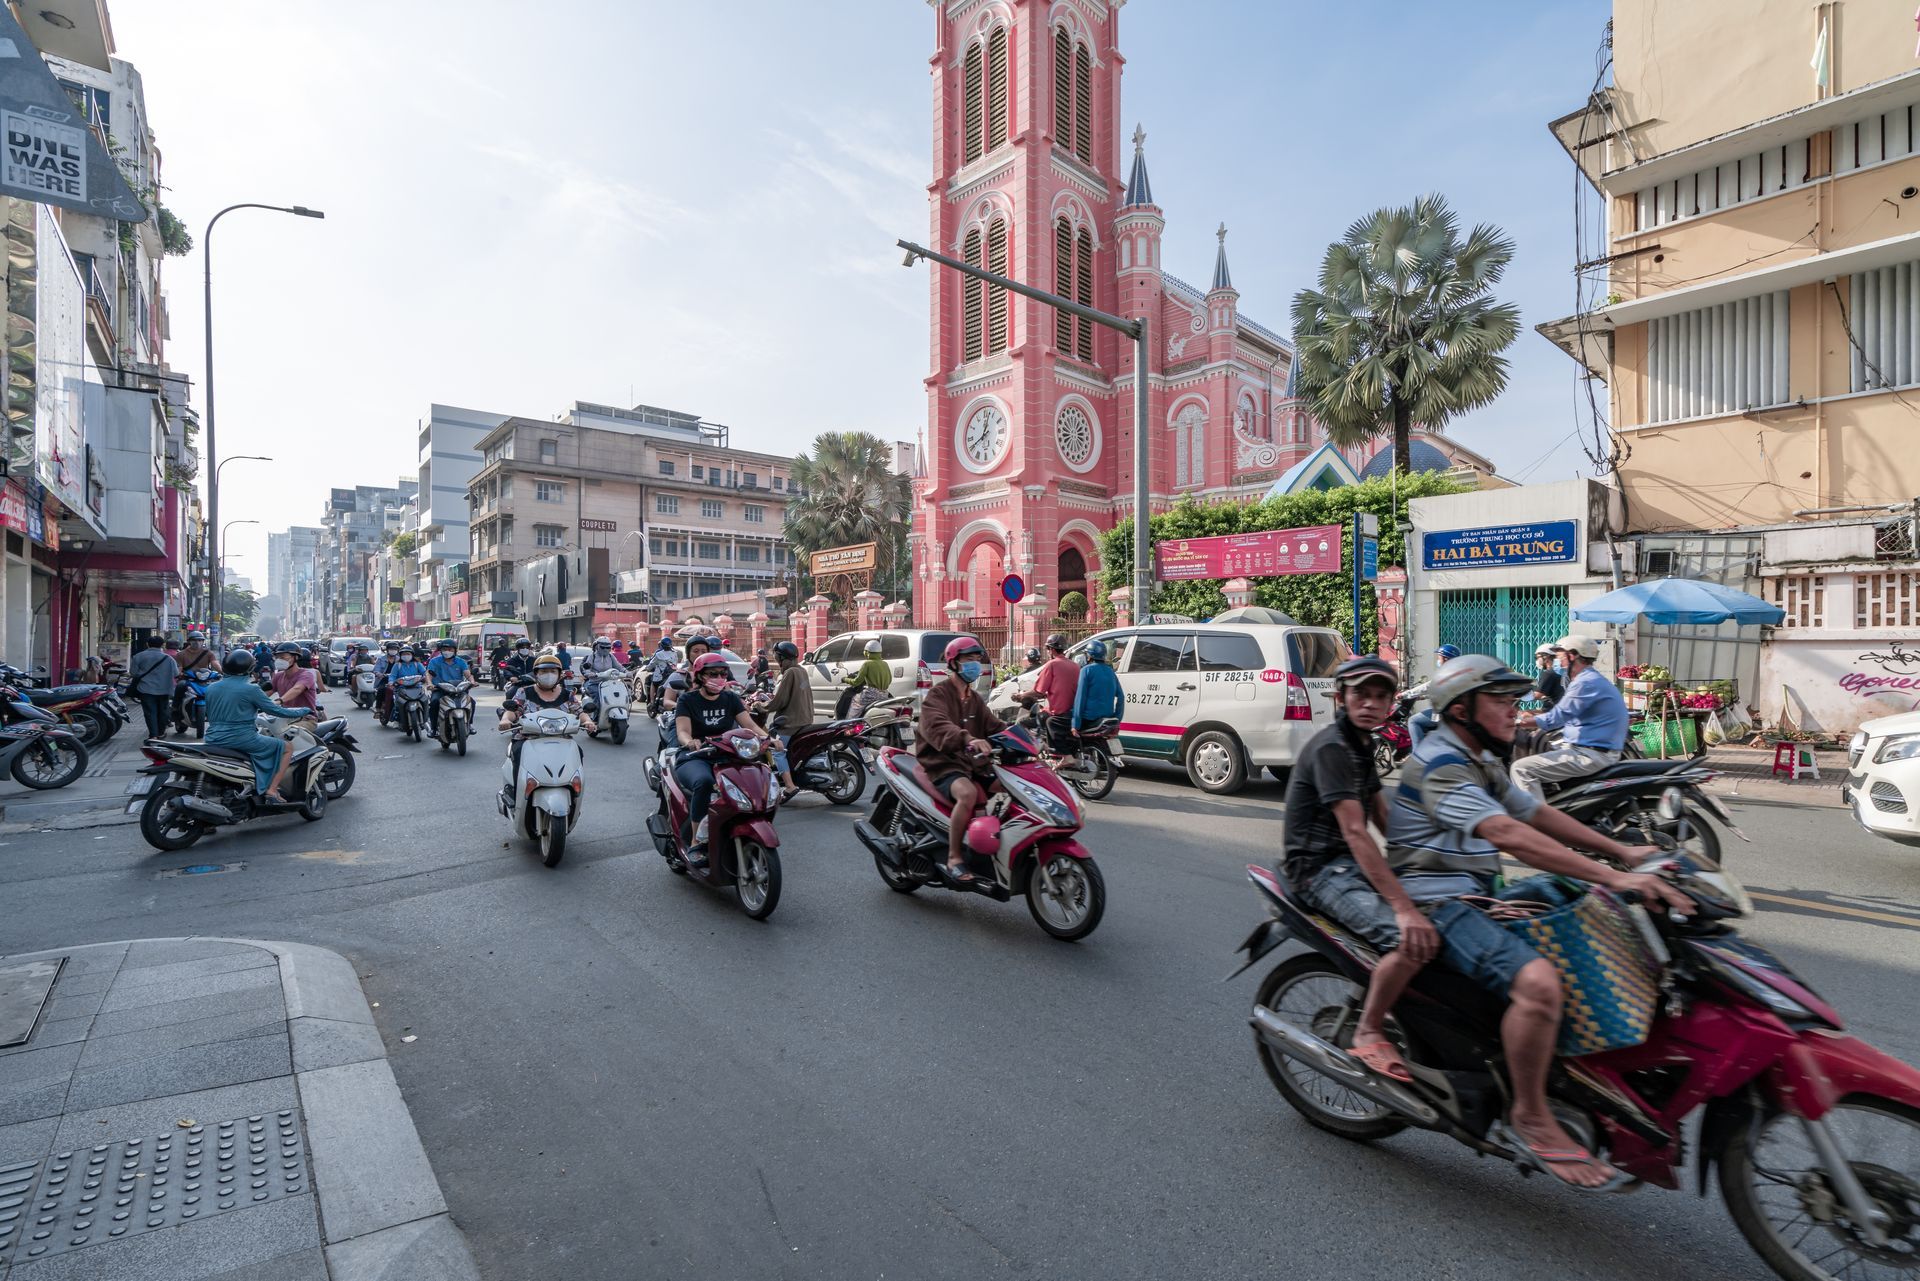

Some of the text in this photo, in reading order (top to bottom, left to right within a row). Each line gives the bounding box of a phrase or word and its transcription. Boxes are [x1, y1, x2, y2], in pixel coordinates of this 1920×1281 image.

[8, 147, 80, 177] WAS
[8, 165, 80, 196] HERE
[581, 520, 615, 530] COUPLE TX
[1433, 540, 1564, 560] HAI BÀ TRƯNG
[1205, 673, 1220, 682] 51F
[1261, 672, 1285, 681] 14404
[1126, 693, 1180, 706] 38.27 27 27
